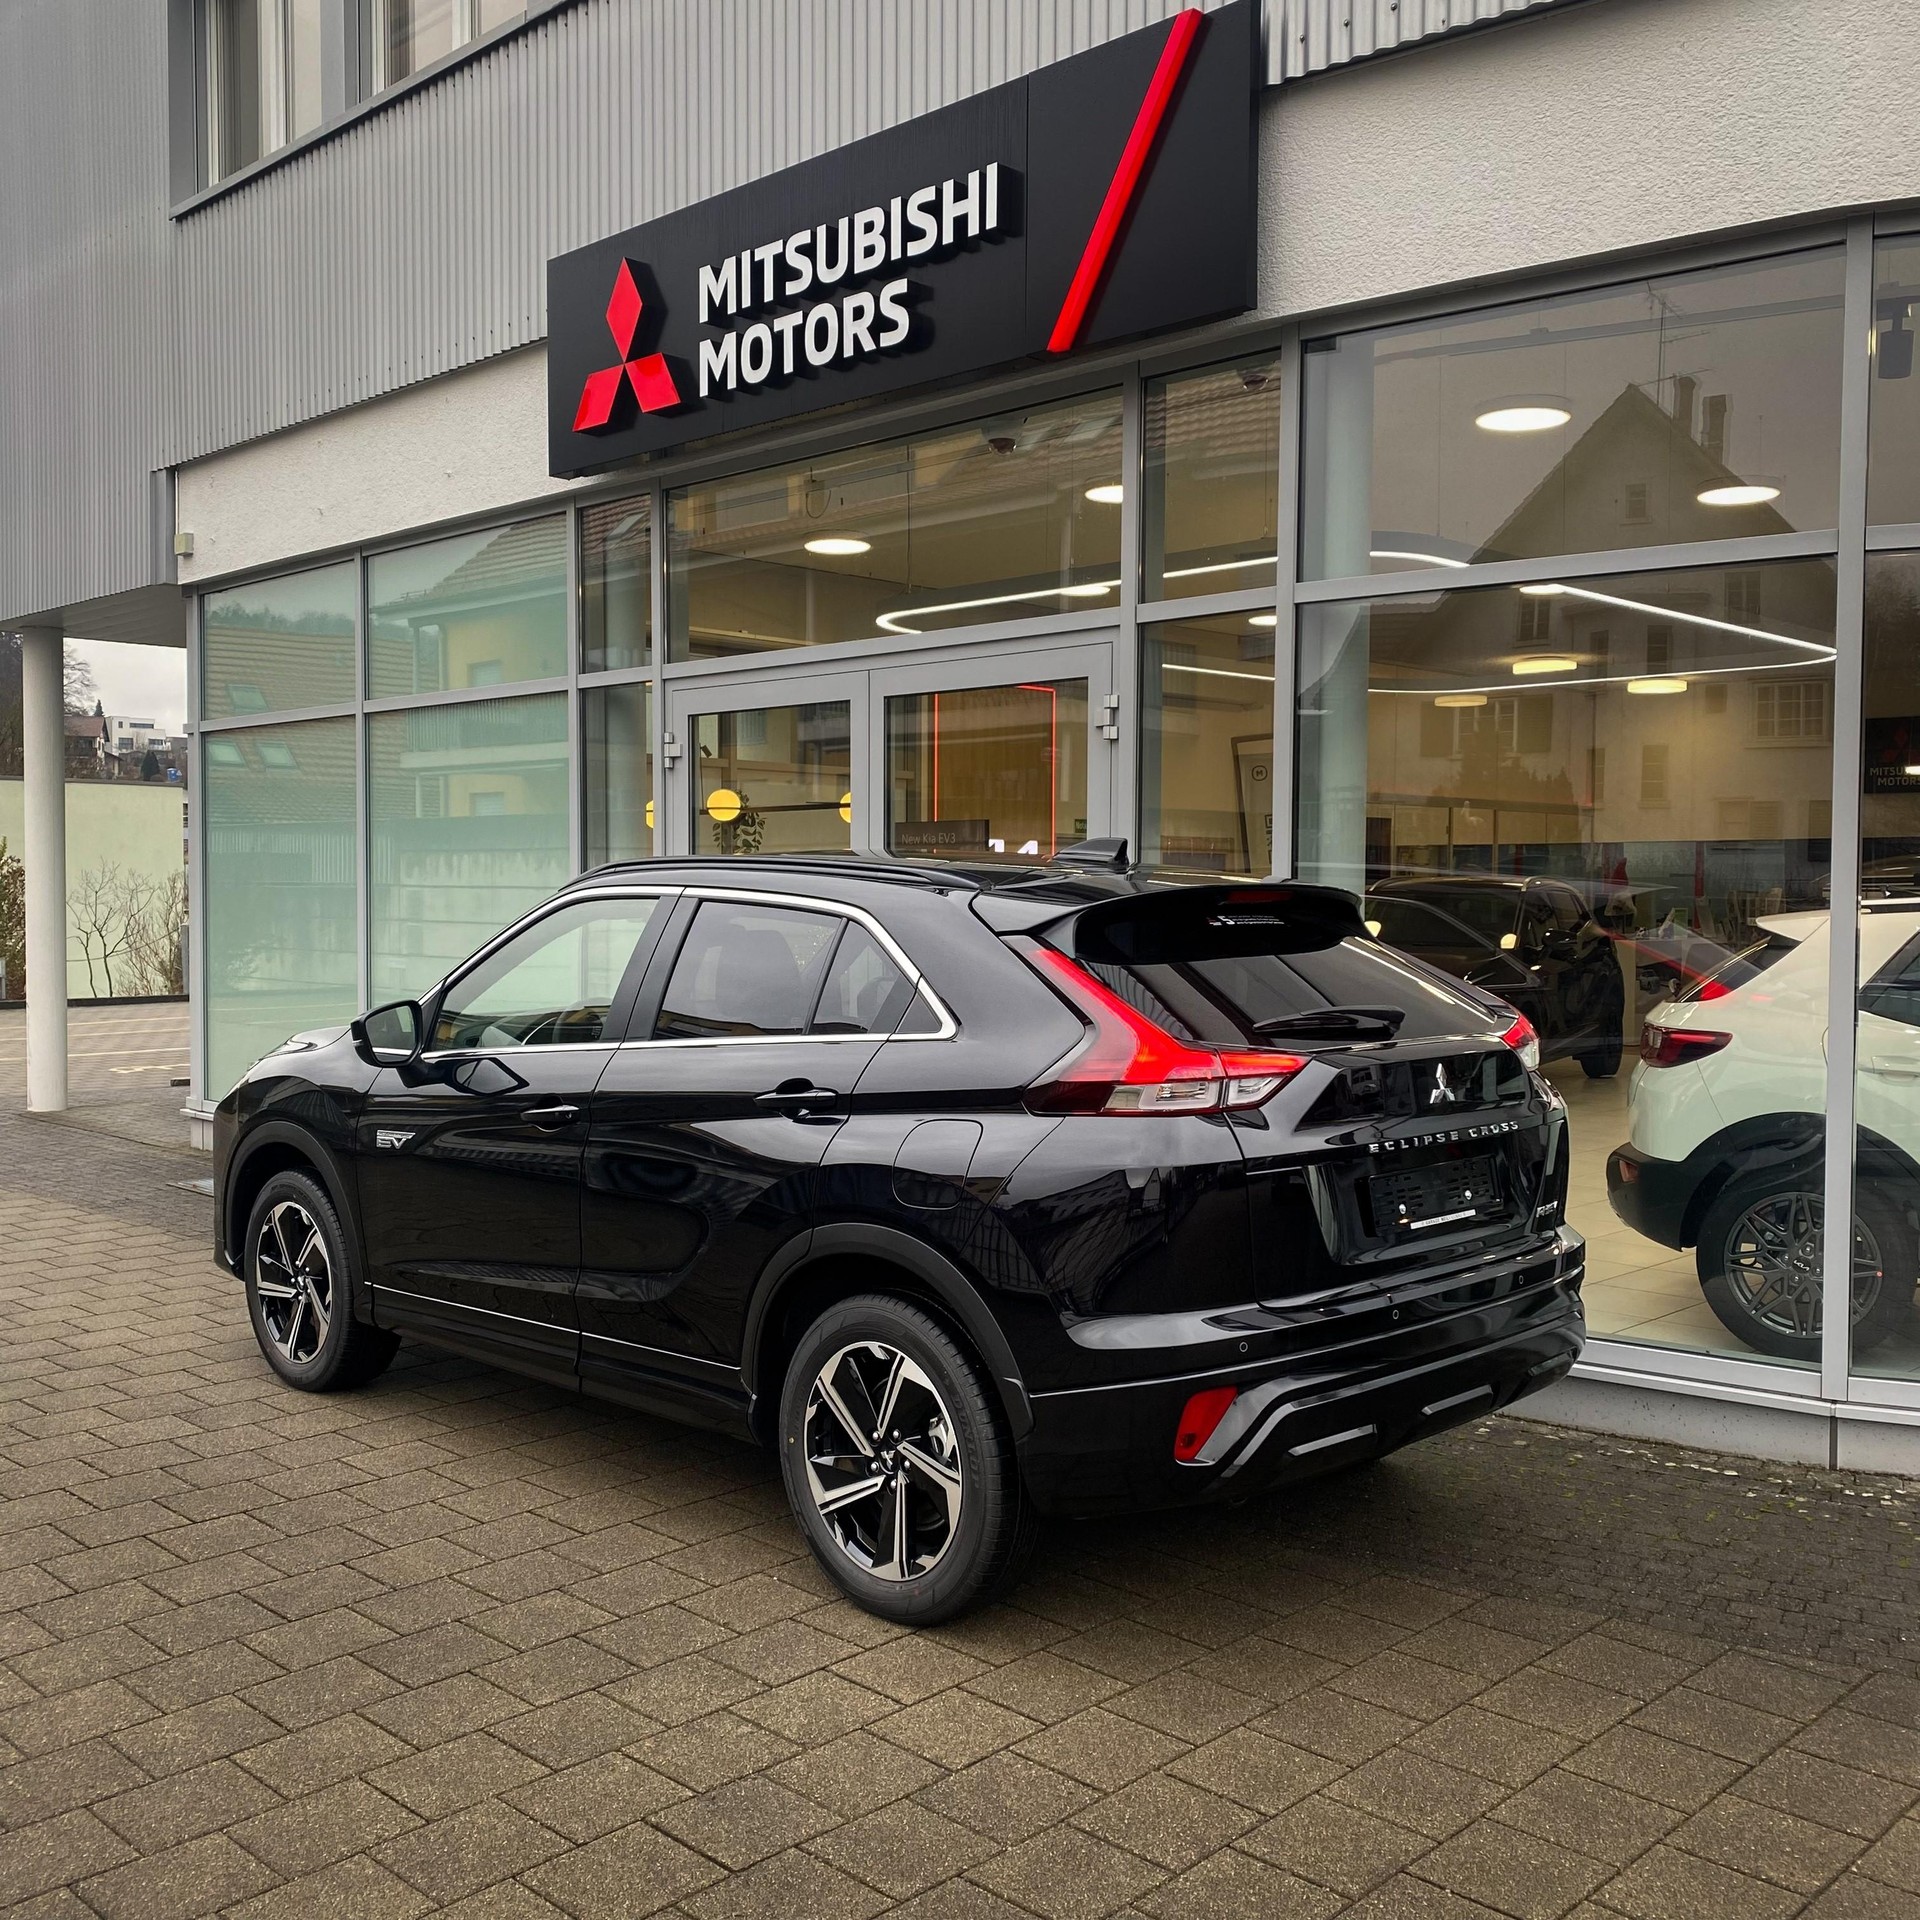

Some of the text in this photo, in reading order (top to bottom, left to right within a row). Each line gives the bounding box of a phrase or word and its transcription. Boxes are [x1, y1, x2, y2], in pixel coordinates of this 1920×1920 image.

[698, 161, 999, 324] MITSUBISHI
[698, 278, 910, 399] MOTORS
[901, 832, 956, 845] New Kia EV3
[1368, 1120, 1519, 1153] ECLIPSE CROSS
